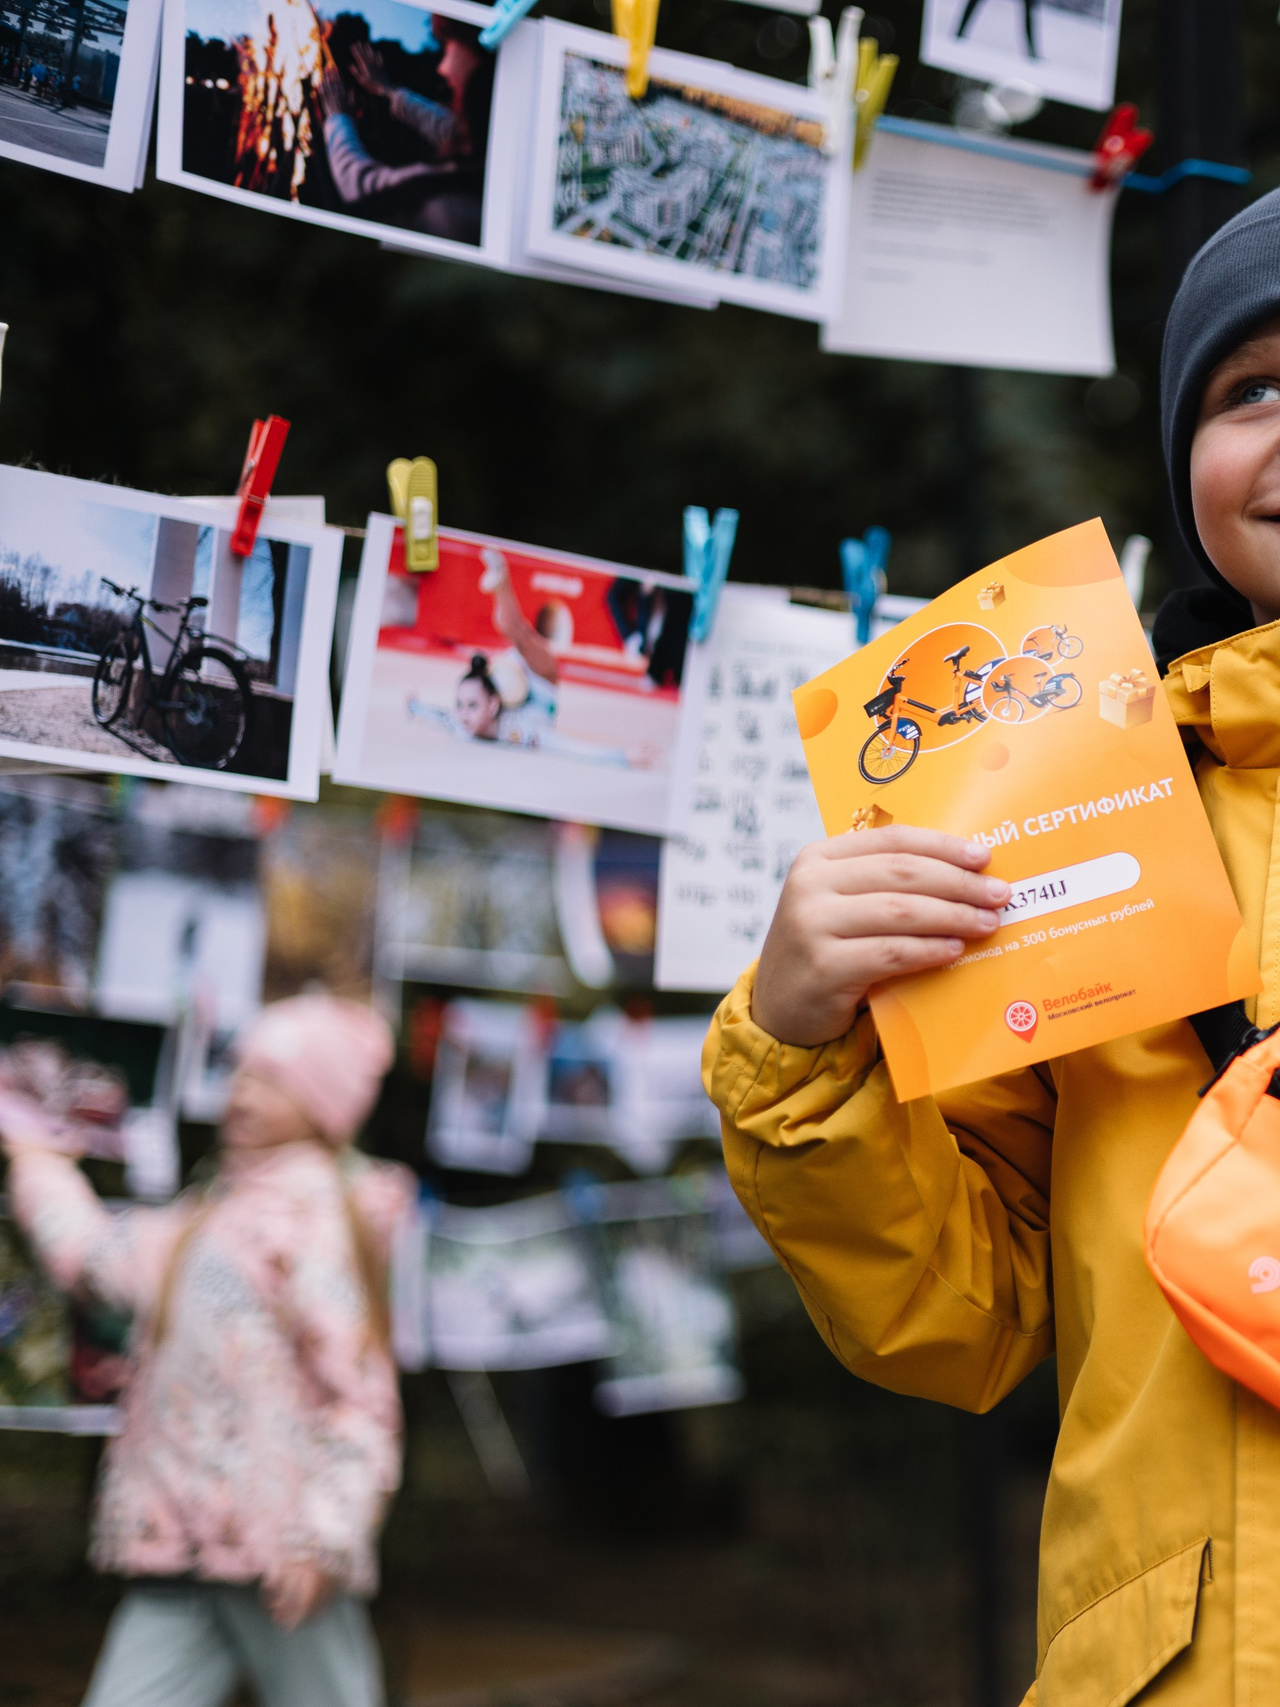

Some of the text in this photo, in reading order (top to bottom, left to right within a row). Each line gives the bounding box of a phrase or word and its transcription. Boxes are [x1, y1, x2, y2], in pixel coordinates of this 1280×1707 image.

[1023, 777, 1174, 836] СЕРТИФИКАТ
[1004, 941, 1020, 953] на
[1022, 930, 1047, 948] 300
[1049, 915, 1108, 938] бонусных
[1110, 898, 1155, 923] рублей
[1042, 982, 1113, 1011] Велобайк
[1047, 989, 1136, 1020] Московский велопрокат
